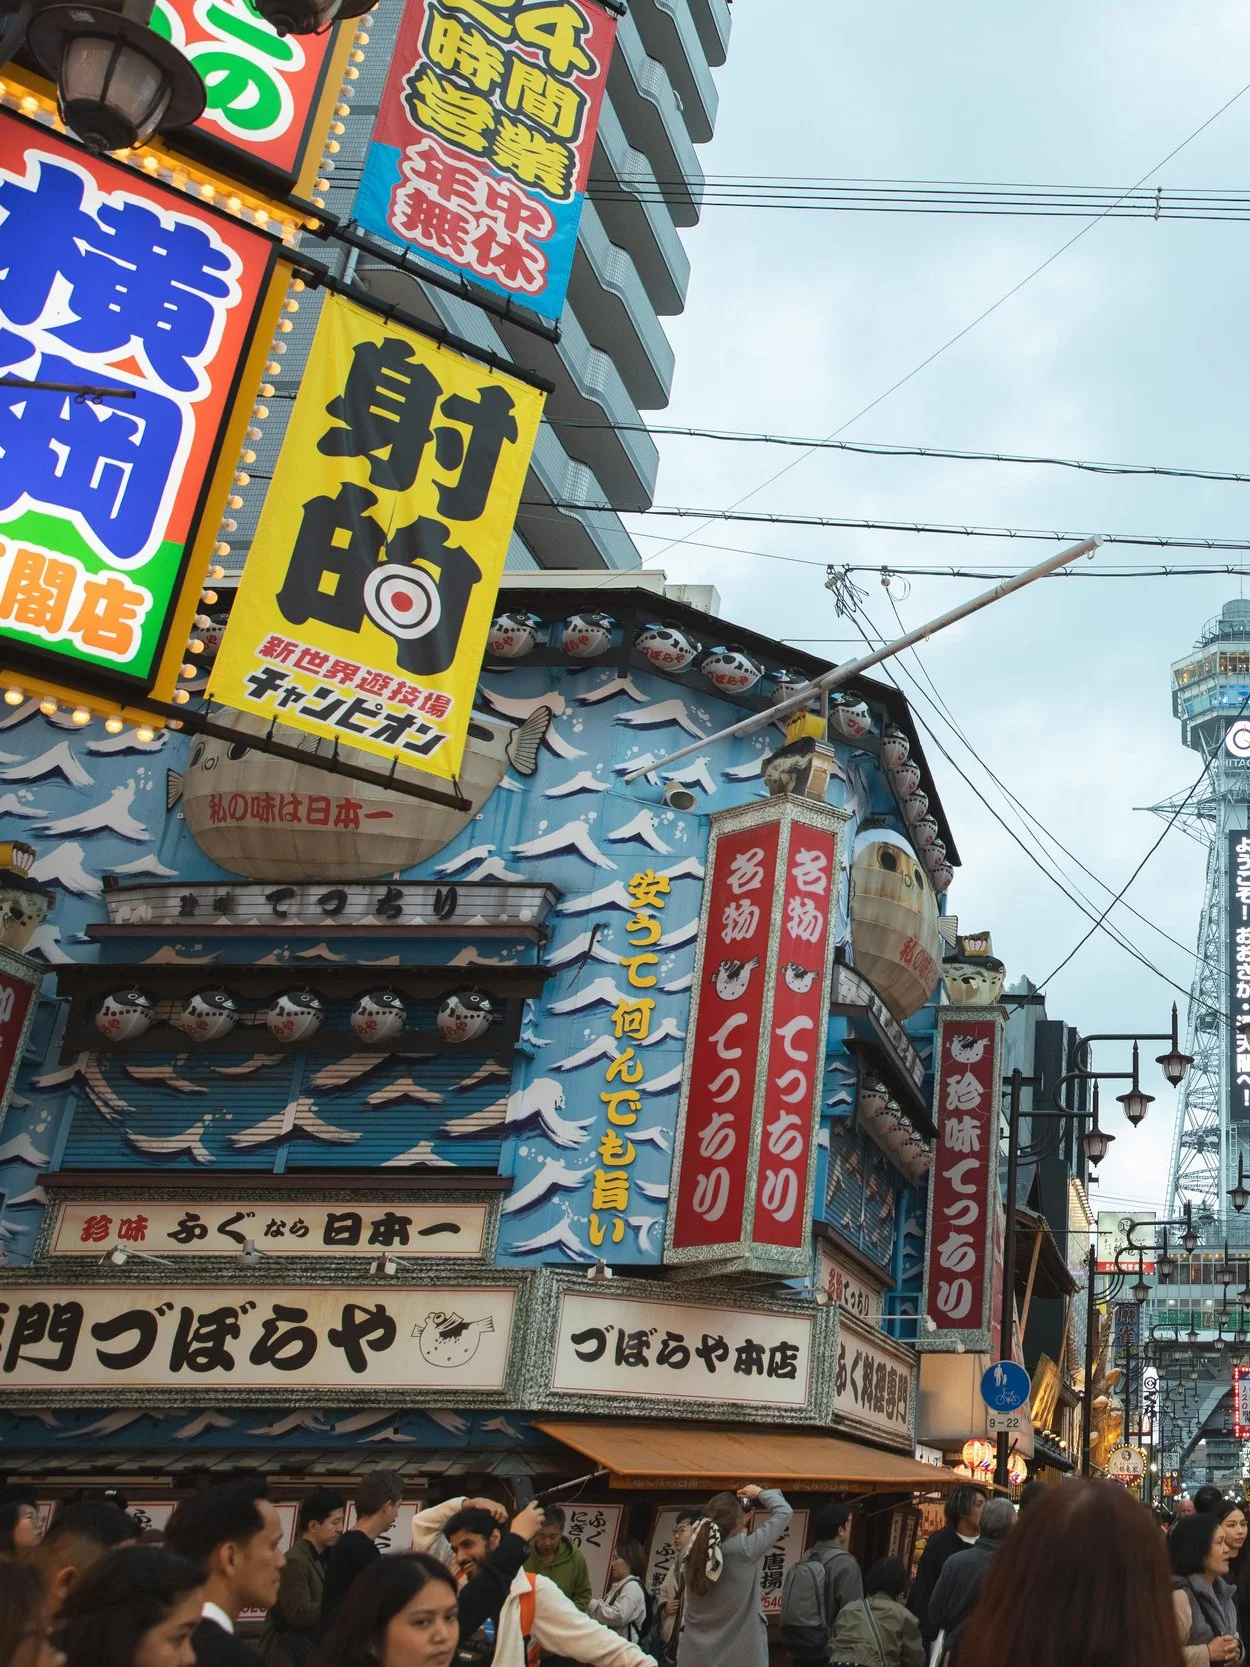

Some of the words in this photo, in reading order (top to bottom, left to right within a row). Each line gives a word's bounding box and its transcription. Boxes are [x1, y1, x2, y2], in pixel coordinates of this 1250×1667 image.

[276, 337, 518, 676] 射的
[0, 548, 146, 656] 閣店
[247, 666, 449, 756] チャンピオン
[258, 635, 453, 718] 新世界遊技場
[208, 792, 394, 830] 私の味は日本一
[720, 847, 766, 944] 名物
[786, 847, 829, 944] 名物
[80, 1214, 149, 1244] 珍味
[570, 1323, 800, 1380] づぼらや本店
[836, 1341, 909, 1425] ふぐ料理専門
[589, 1510, 607, 1548] ふぐ
